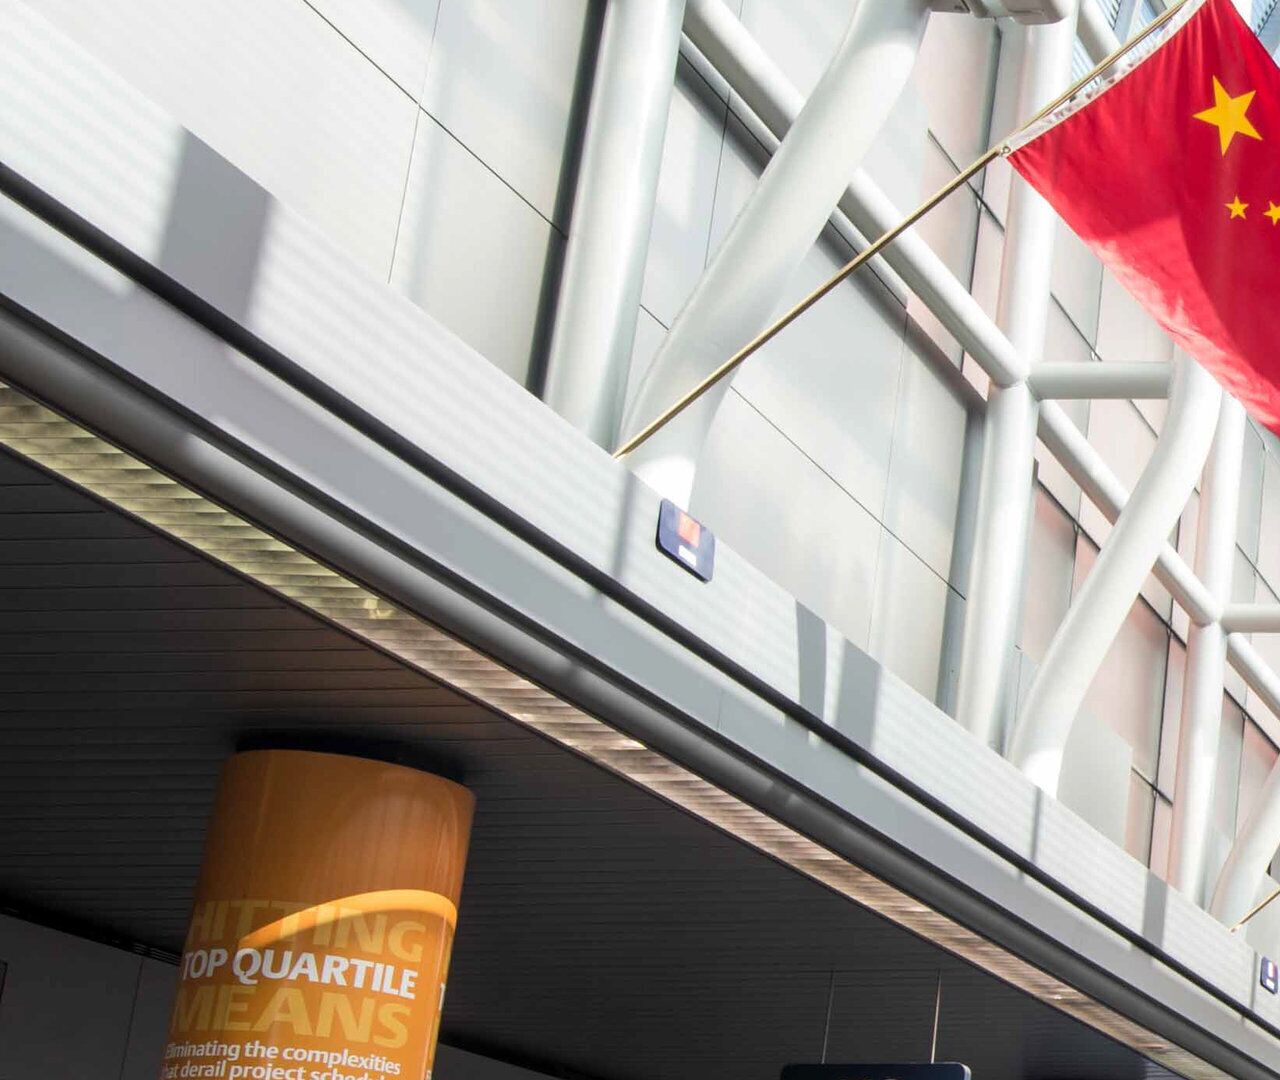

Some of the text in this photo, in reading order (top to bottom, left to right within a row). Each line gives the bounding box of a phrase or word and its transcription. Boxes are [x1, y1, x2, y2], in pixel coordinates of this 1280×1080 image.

[182, 949, 227, 981] TOP
[232, 947, 419, 999] QUARTILE
[181, 1060, 227, 1077] derail
[244, 1040, 279, 1060] the
[282, 1046, 401, 1076] complexities
